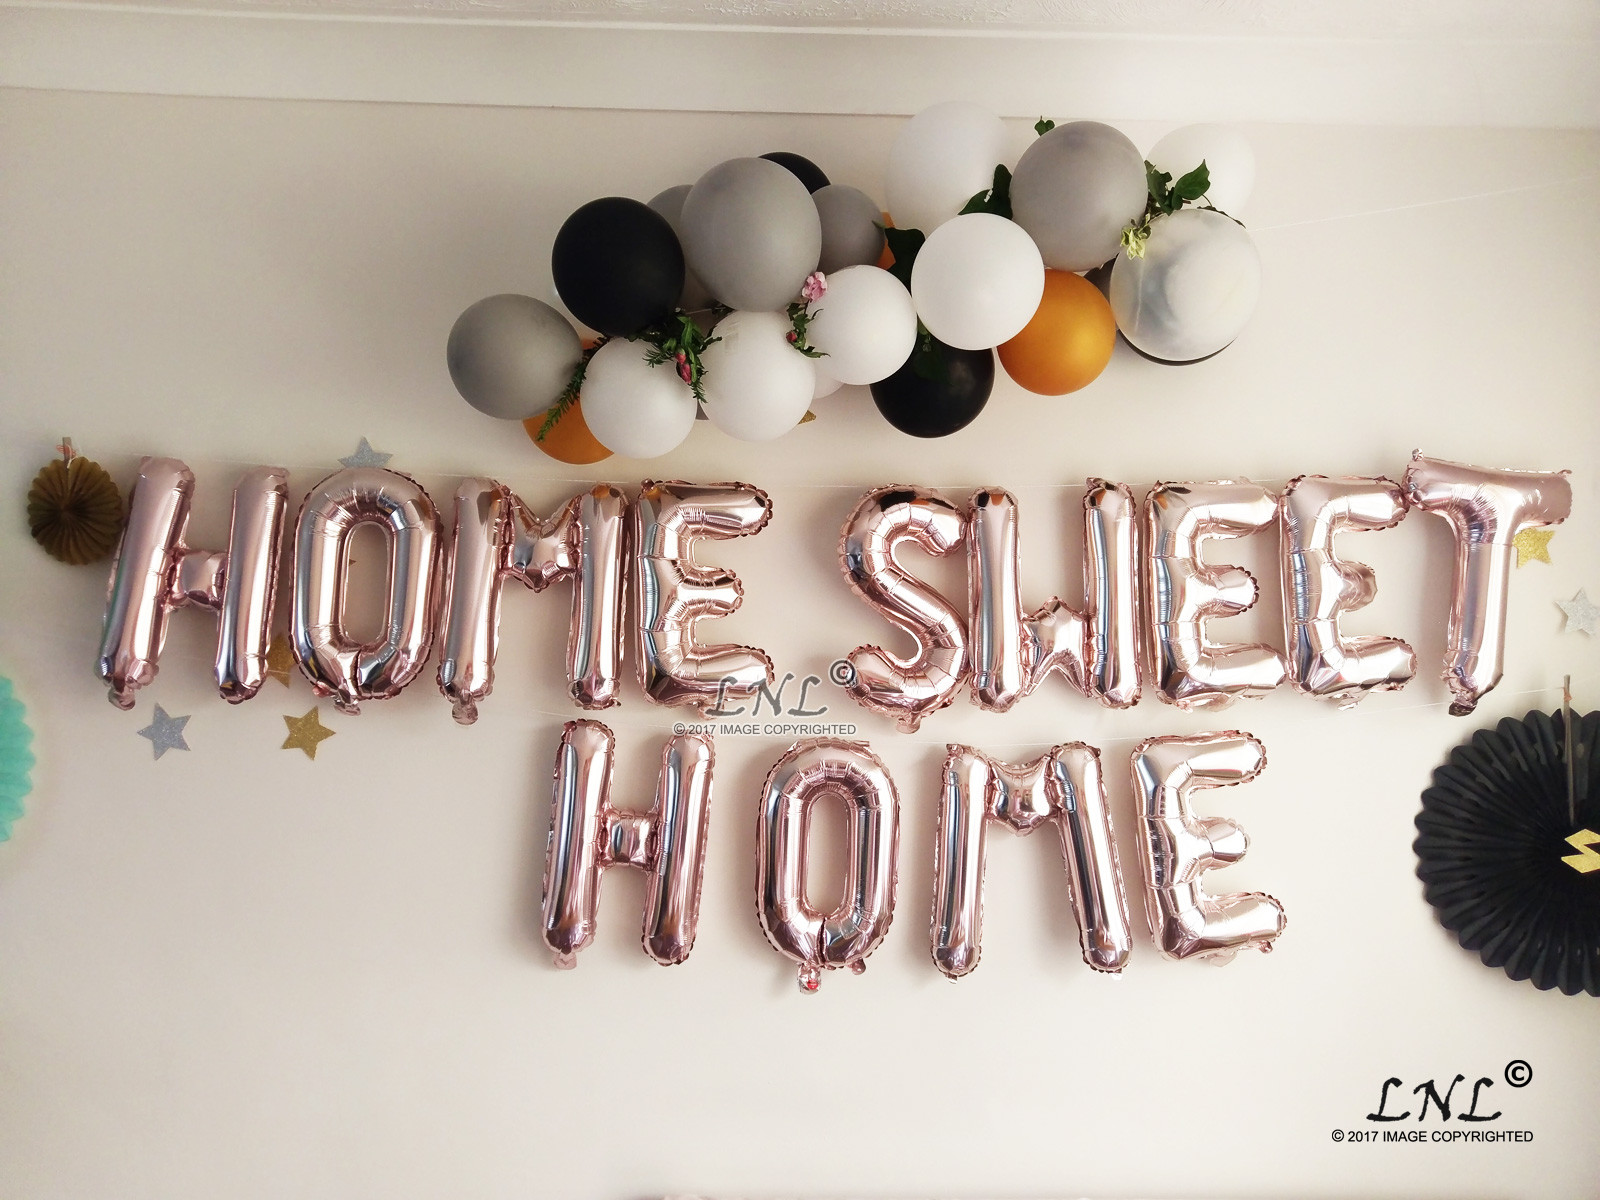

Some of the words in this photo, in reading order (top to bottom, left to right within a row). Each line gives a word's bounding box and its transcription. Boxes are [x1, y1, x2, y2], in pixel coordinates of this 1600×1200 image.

[95, 455, 775, 724] HOME
[836, 449, 1574, 734] SWEET
[539, 718, 1288, 993] HOME
